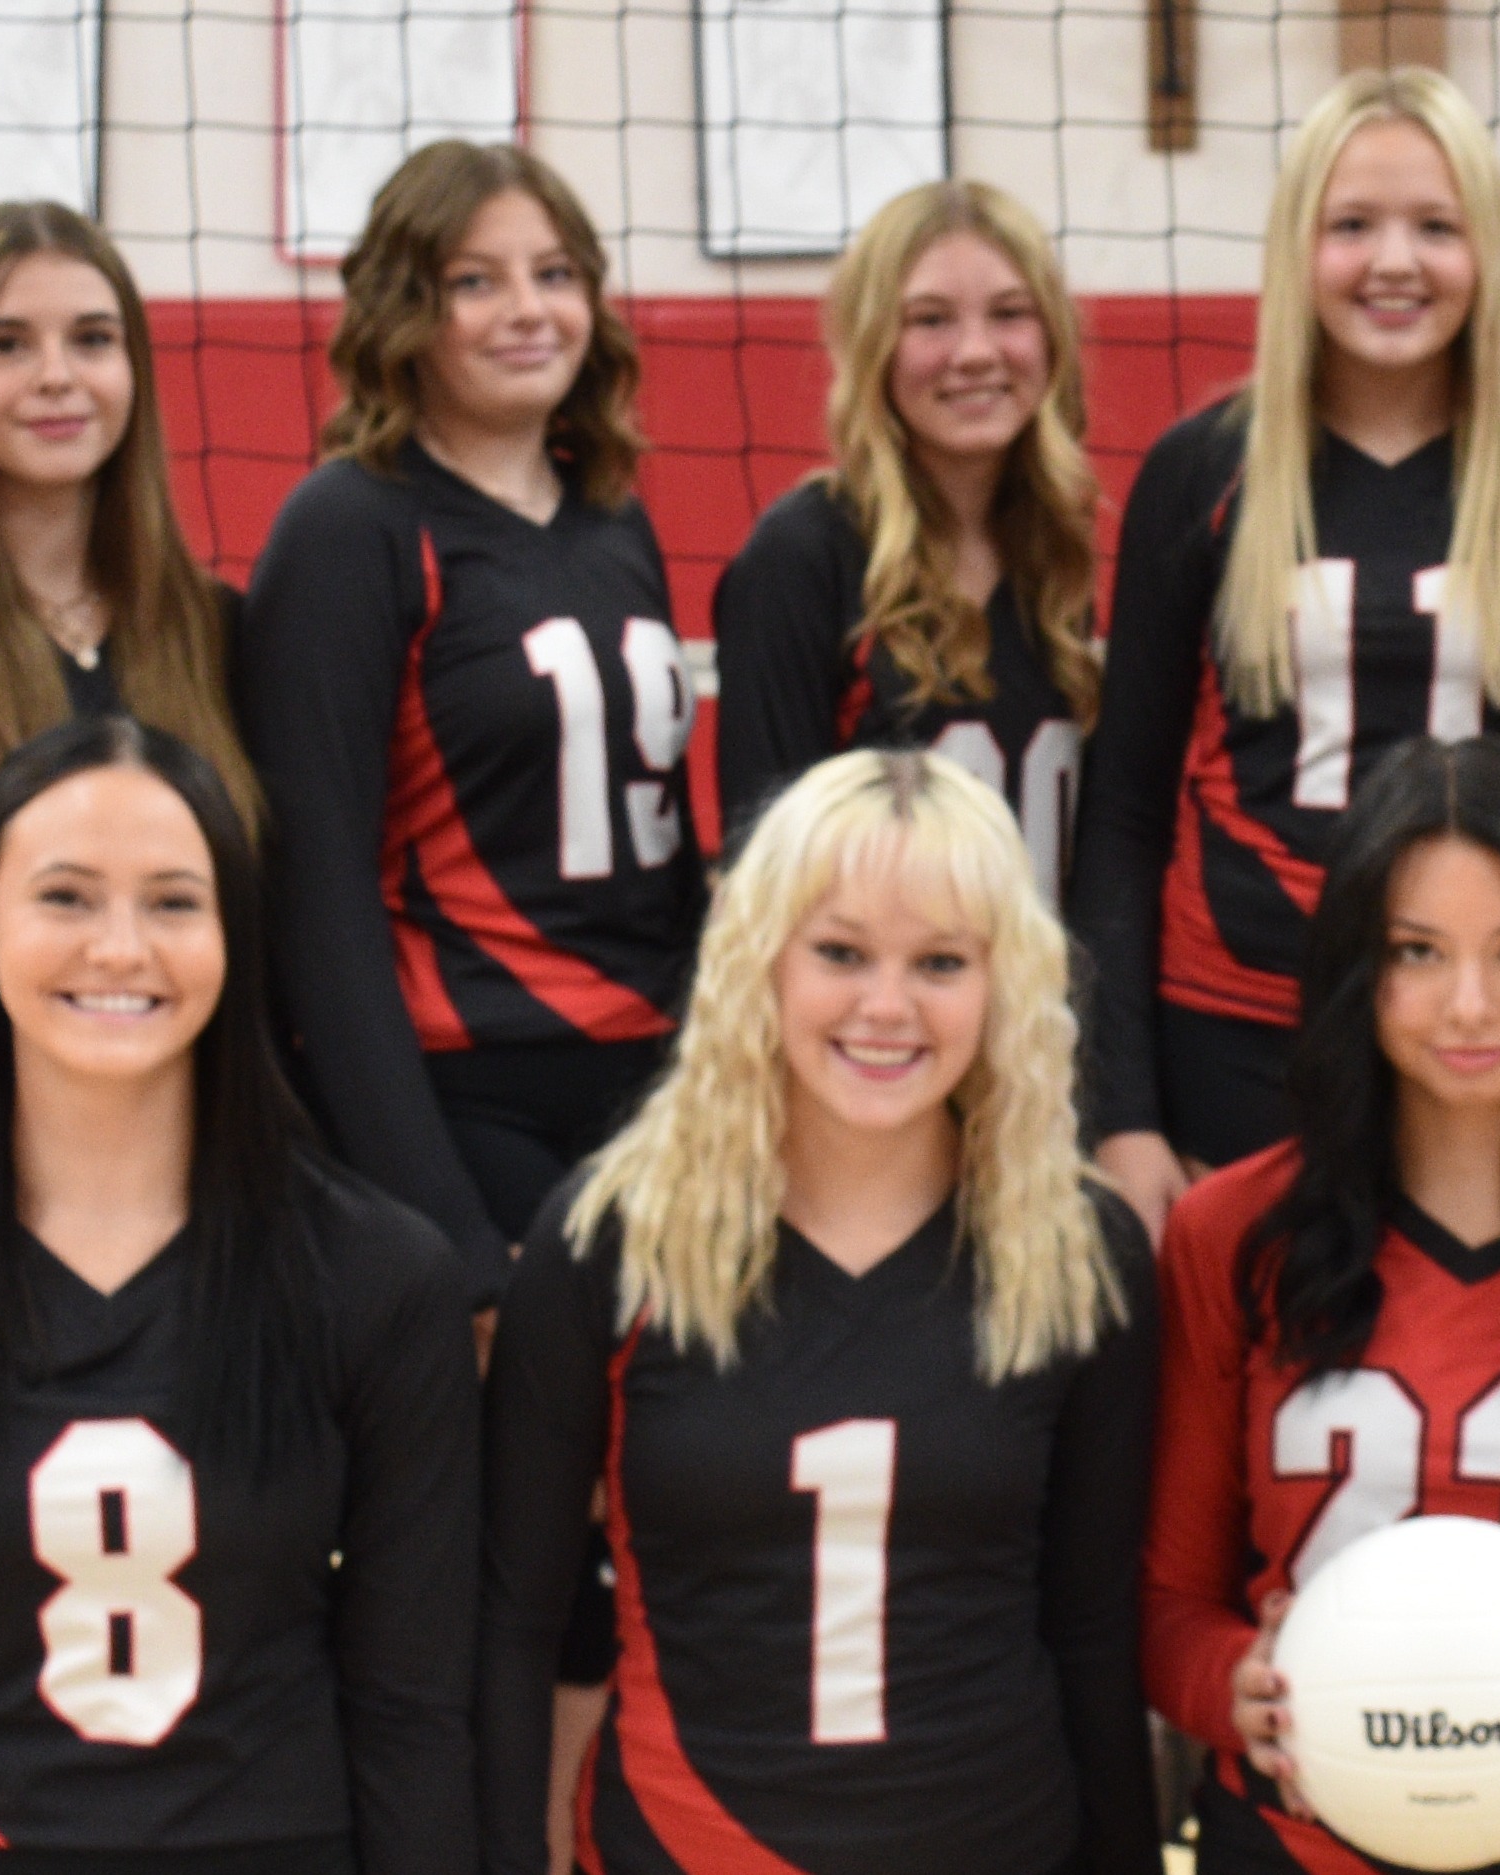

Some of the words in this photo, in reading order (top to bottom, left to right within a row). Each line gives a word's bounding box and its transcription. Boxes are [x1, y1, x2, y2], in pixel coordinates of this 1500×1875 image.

[522, 615, 696, 880] 19
[1286, 556, 1485, 811] 11
[28, 1416, 203, 1748] 8
[790, 1417, 898, 1745] 1
